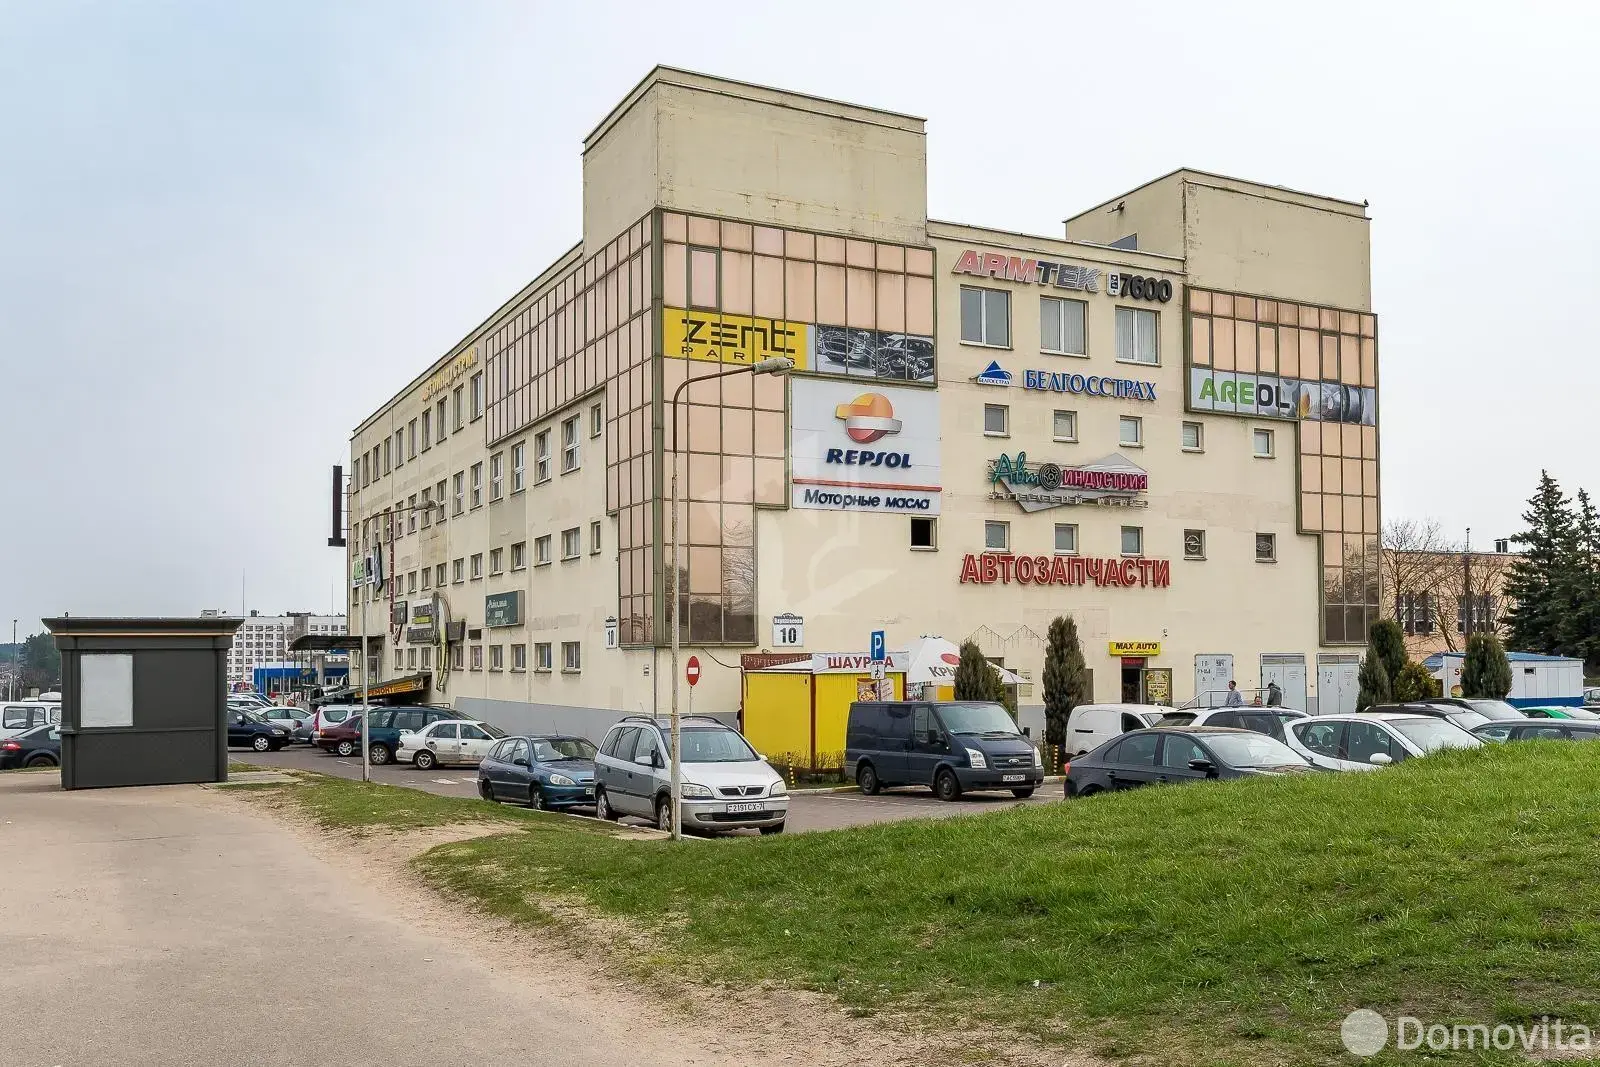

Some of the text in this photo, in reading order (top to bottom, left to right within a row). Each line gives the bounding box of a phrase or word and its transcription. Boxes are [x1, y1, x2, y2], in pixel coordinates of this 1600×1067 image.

[952, 250, 1172, 303] ARMTEK 7600
[1023, 369, 1157, 401] БЕЛГОССТРАХ
[826, 448, 912, 469] REPSOL
[803, 488, 930, 510] Моторные масла
[960, 553, 1171, 588] АВТОЗАПЧАСТИ
[780, 627, 797, 643] 10
[1115, 642, 1158, 650] MAX AUTO
[827, 655, 894, 670] ШАУРА
